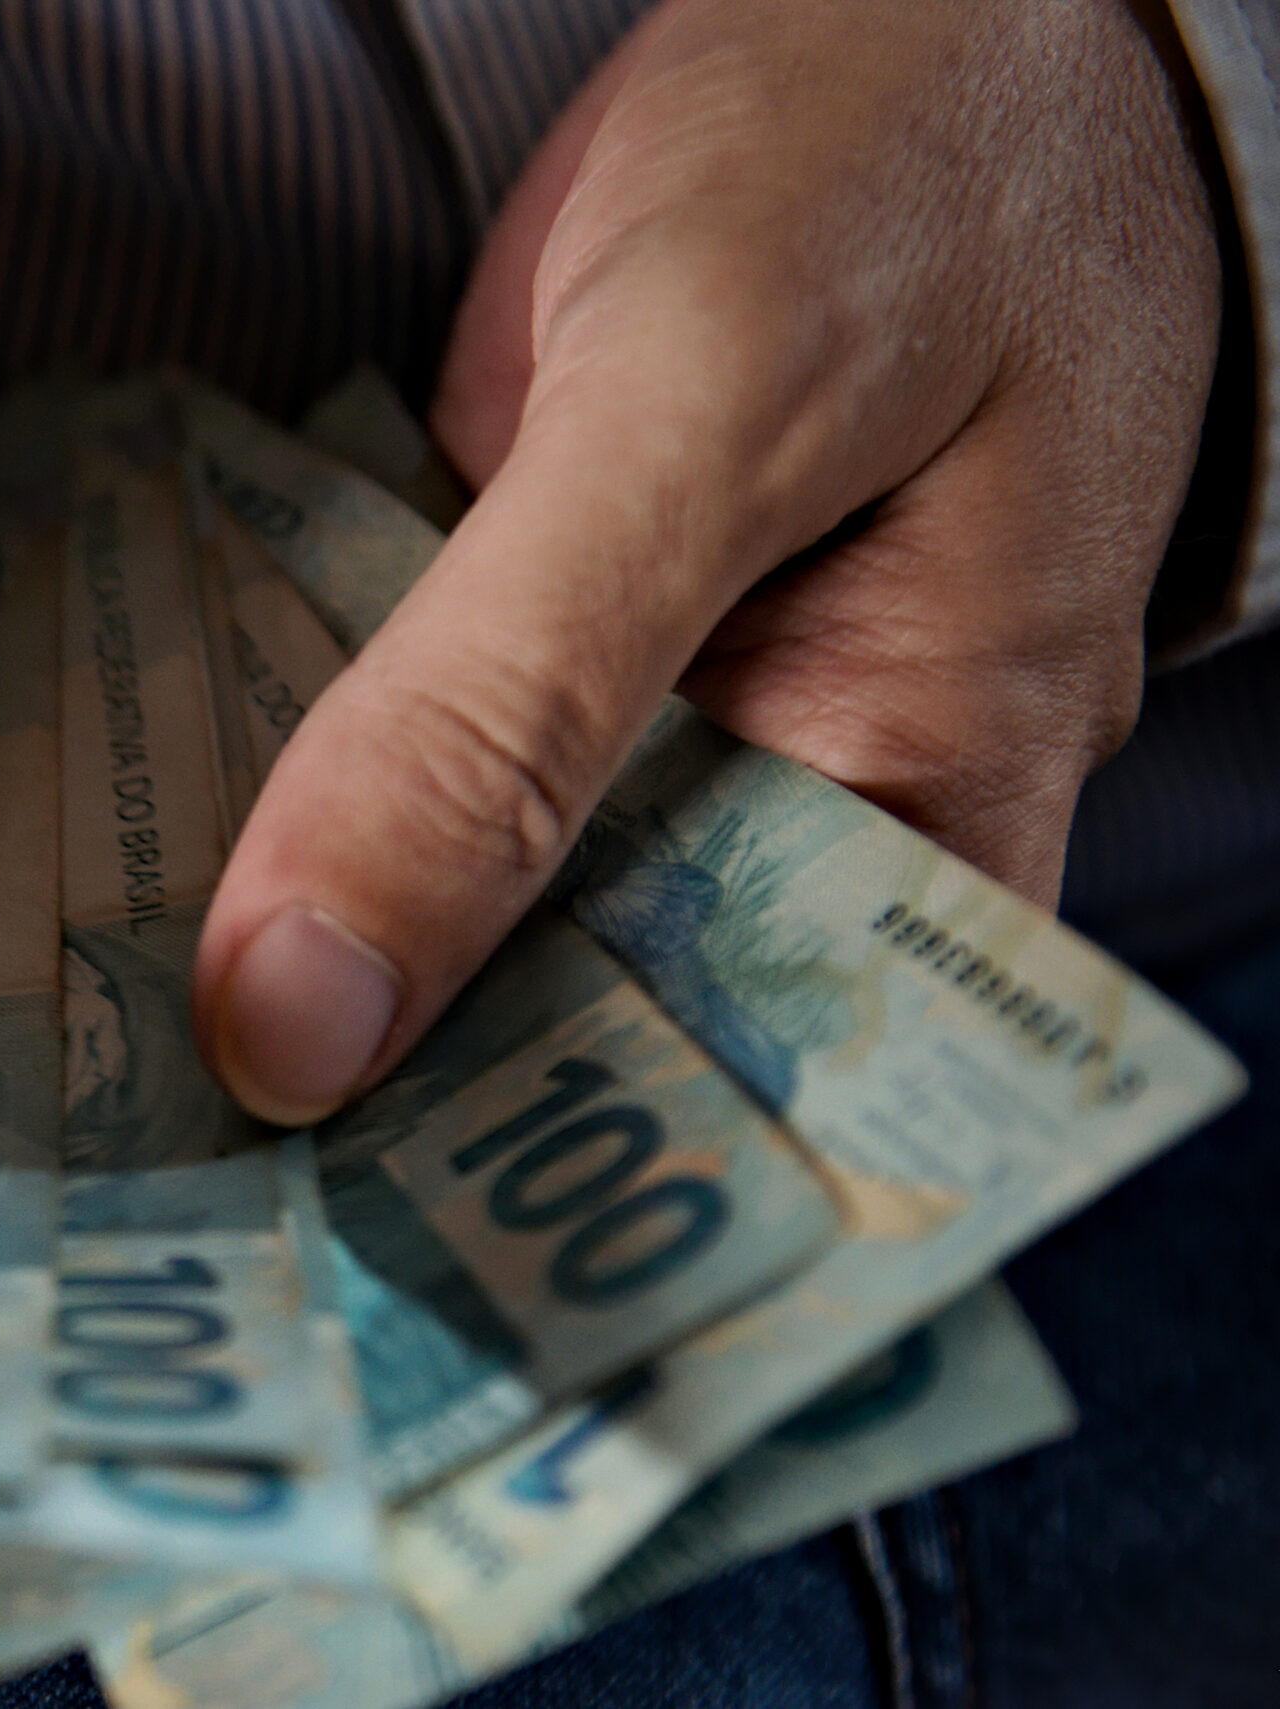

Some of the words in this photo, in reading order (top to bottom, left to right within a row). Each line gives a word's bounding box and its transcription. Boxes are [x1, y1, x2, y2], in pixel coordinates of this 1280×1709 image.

[112, 776, 157, 823] DO
[122, 828, 168, 938] BRASIL
[452, 1058, 732, 1306] 100
[54, 1255, 240, 1420] 100
